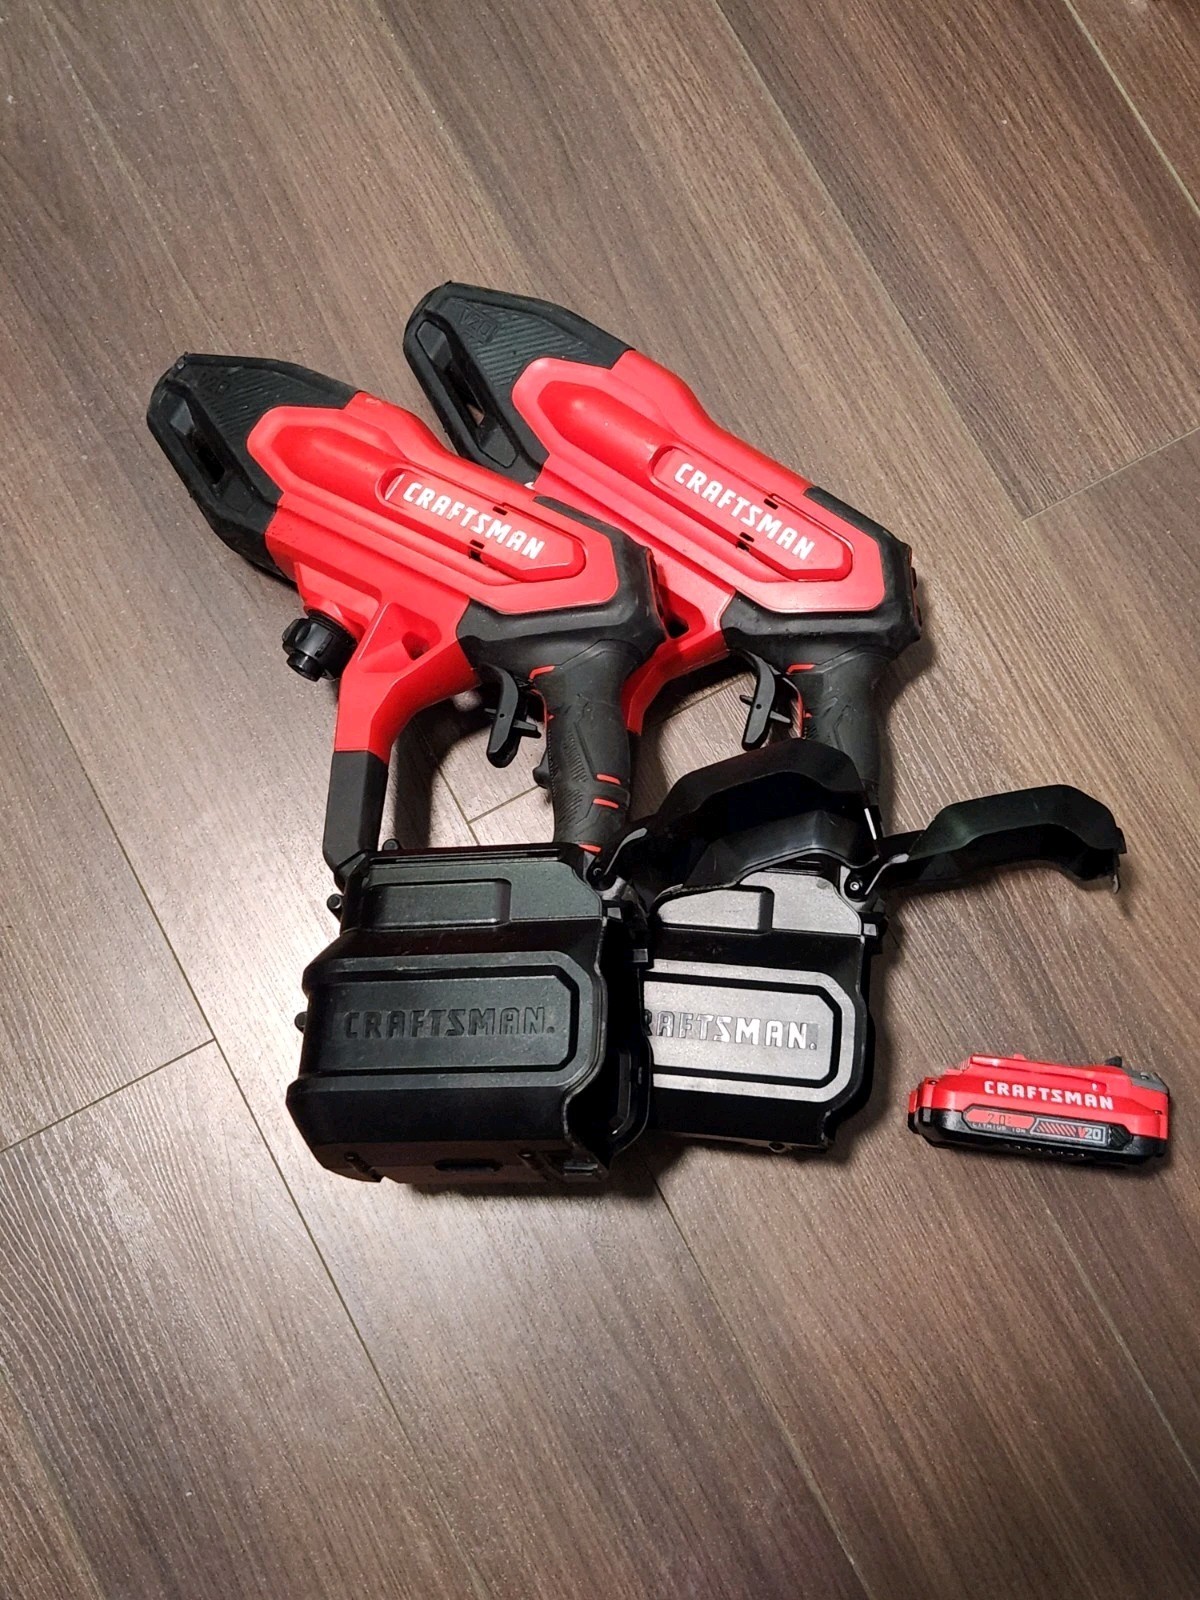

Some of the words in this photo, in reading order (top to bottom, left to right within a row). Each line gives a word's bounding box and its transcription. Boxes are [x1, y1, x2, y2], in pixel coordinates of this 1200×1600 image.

[403, 482, 545, 559] CRAFTSMAN
[674, 462, 815, 560] CRAFTSMAN
[984, 1080, 1114, 1110] CRAFTSMAN
[1077, 1126, 1101, 1140] V20
